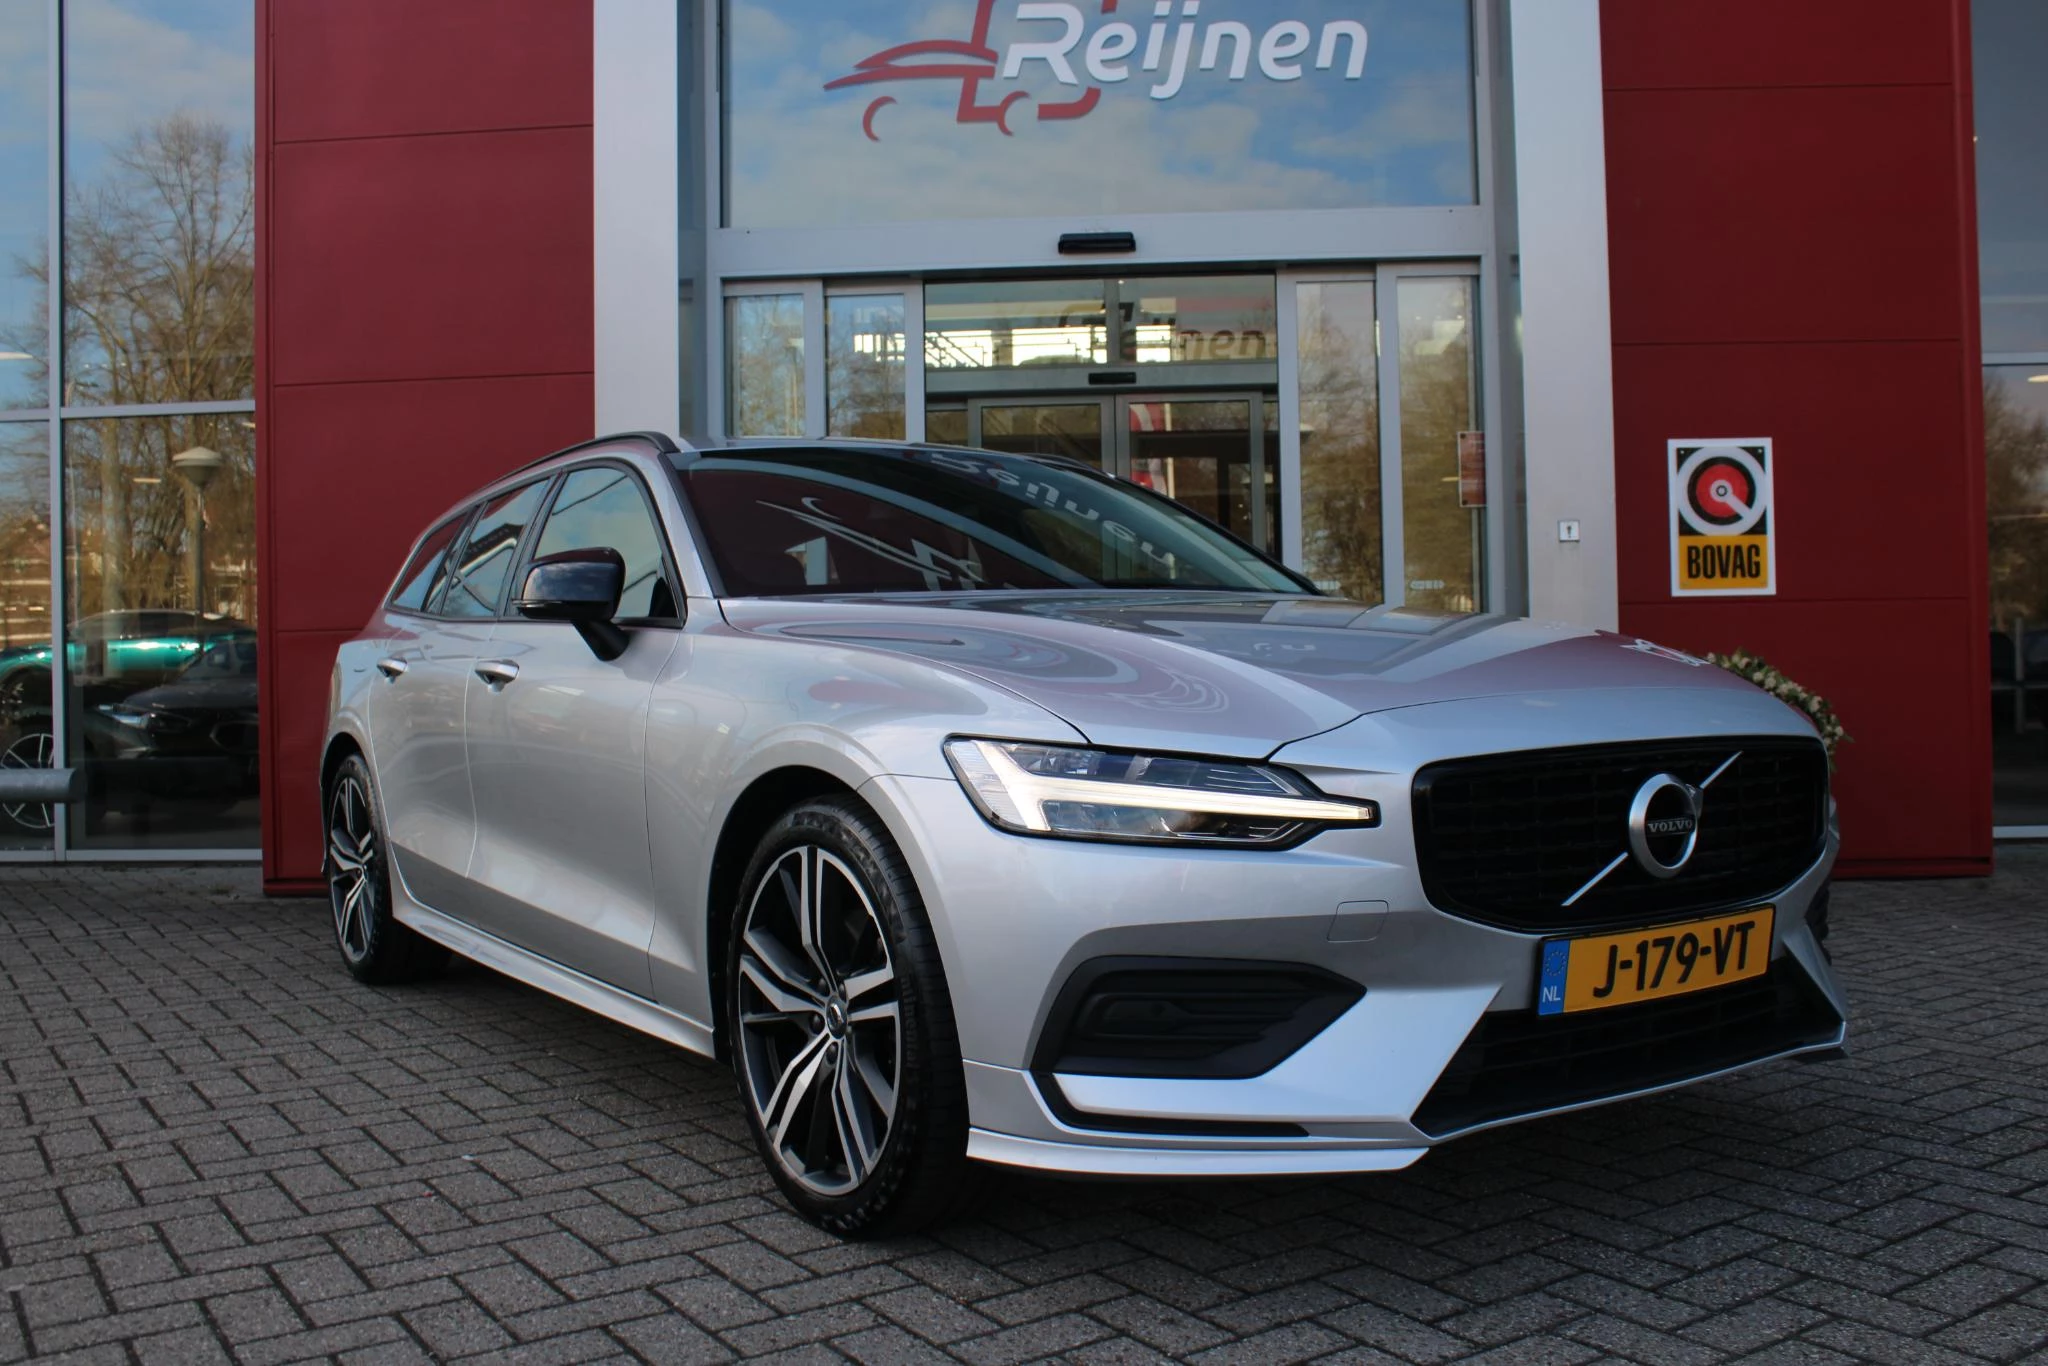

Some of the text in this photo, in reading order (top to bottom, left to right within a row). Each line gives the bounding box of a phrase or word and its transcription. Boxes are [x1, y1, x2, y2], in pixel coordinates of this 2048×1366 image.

[1002, 0, 1368, 100] Reijnen
[1687, 544, 1761, 579] BOVAG
[1647, 820, 1693, 832] VOLVO
[1593, 920, 1755, 998] J-179-VT
[1542, 986, 1561, 1003] NL
